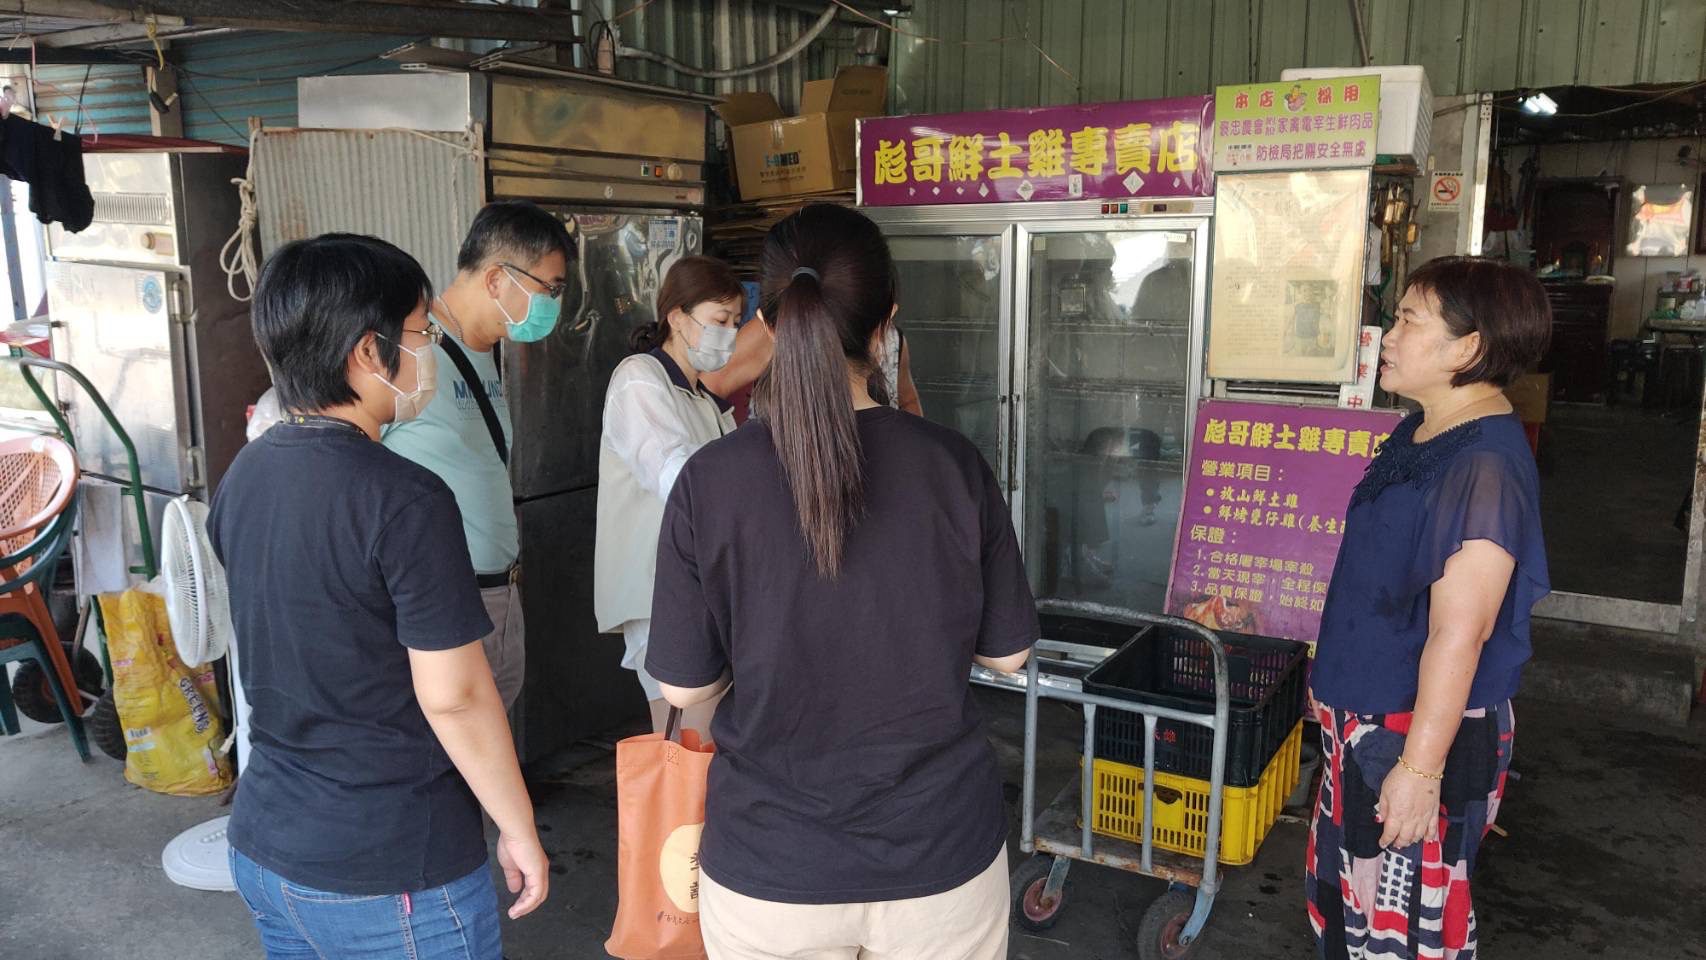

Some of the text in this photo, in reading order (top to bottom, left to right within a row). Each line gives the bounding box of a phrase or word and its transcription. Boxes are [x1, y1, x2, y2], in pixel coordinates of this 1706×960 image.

[1235, 84, 1360, 109] 本店 採用
[874, 120, 1200, 185] 彪哥鮮土雞專賣店
